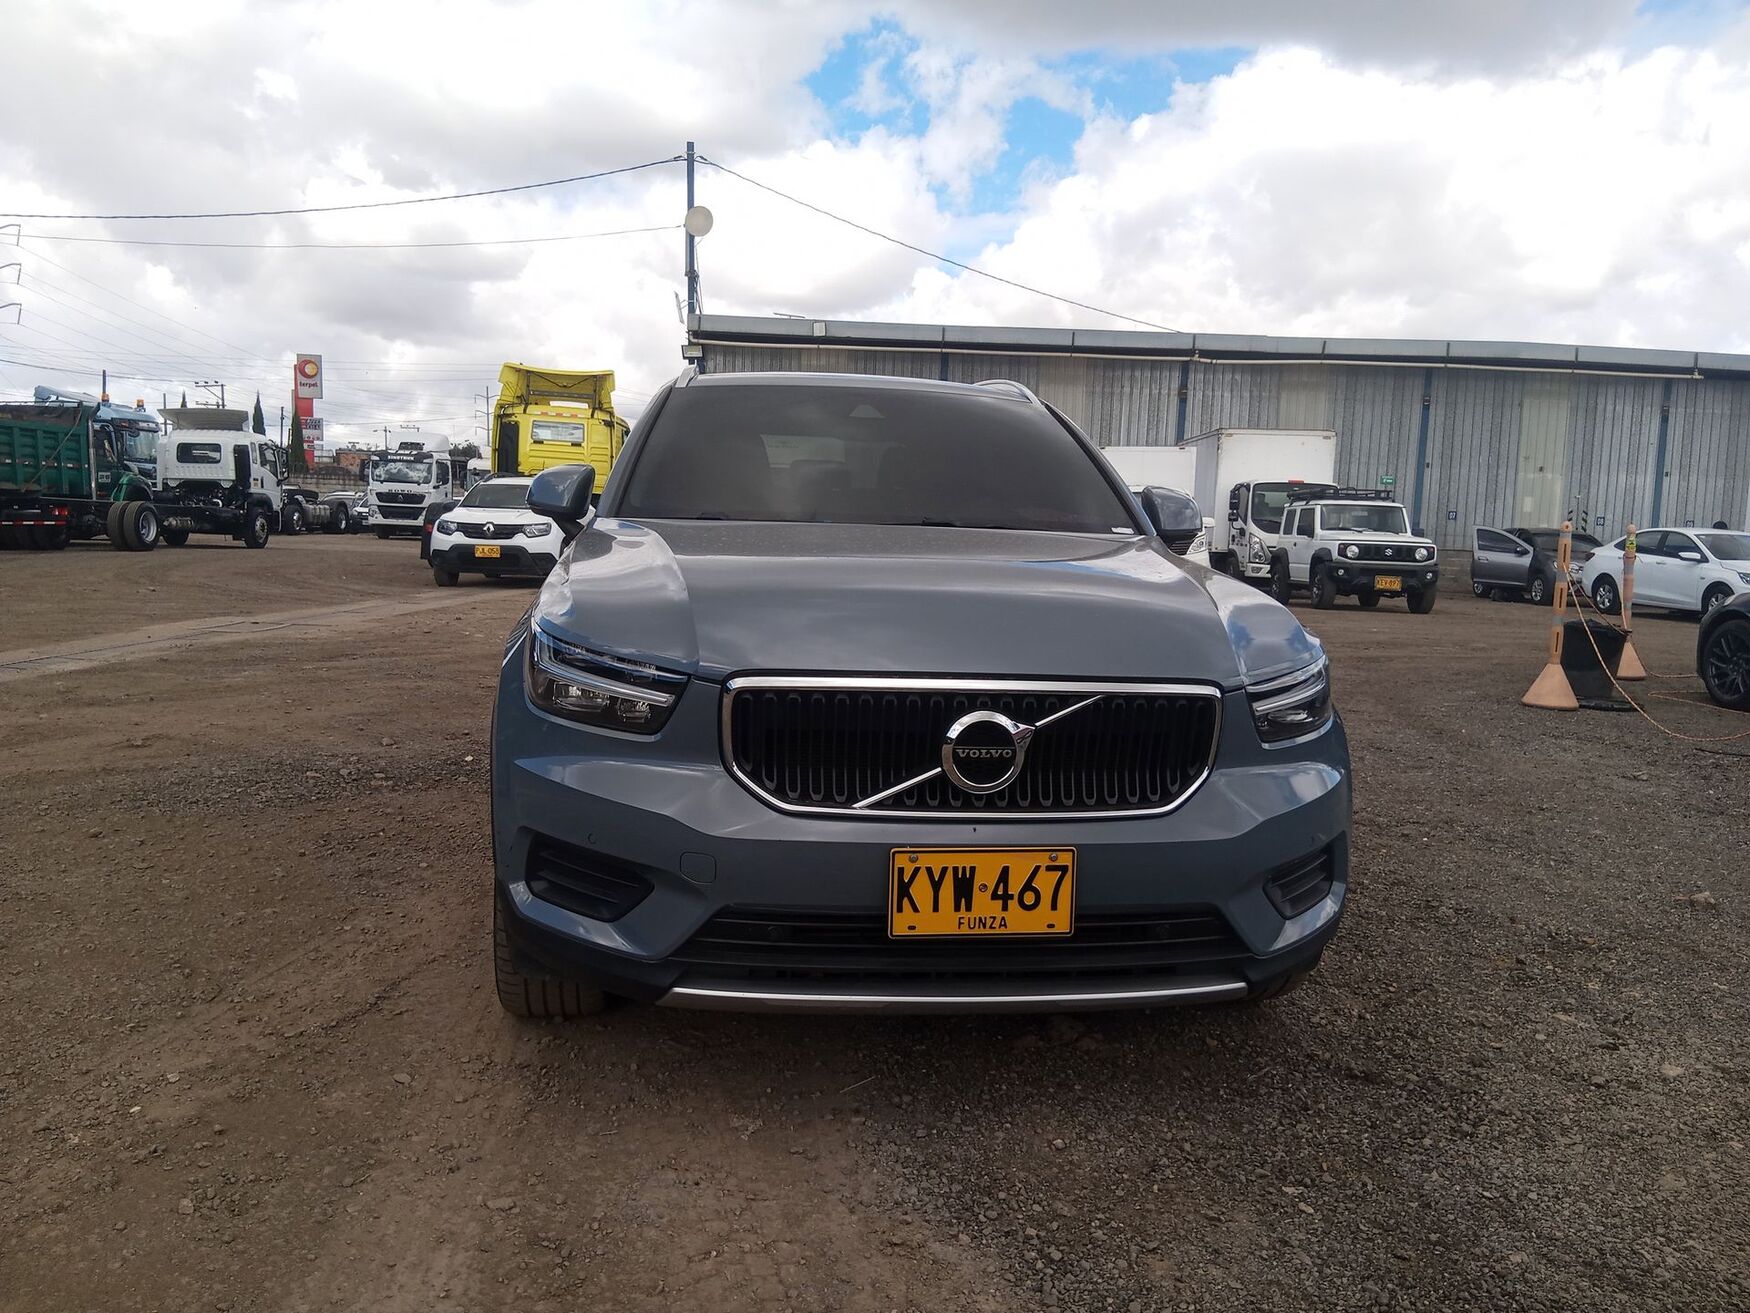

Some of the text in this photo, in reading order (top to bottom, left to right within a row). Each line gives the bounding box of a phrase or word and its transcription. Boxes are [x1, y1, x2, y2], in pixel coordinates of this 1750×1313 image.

[299, 380, 319, 389] terpel
[956, 749, 1013, 758] VOLVO
[896, 864, 1070, 913] KYW 467
[957, 916, 1008, 930] FUNZA
